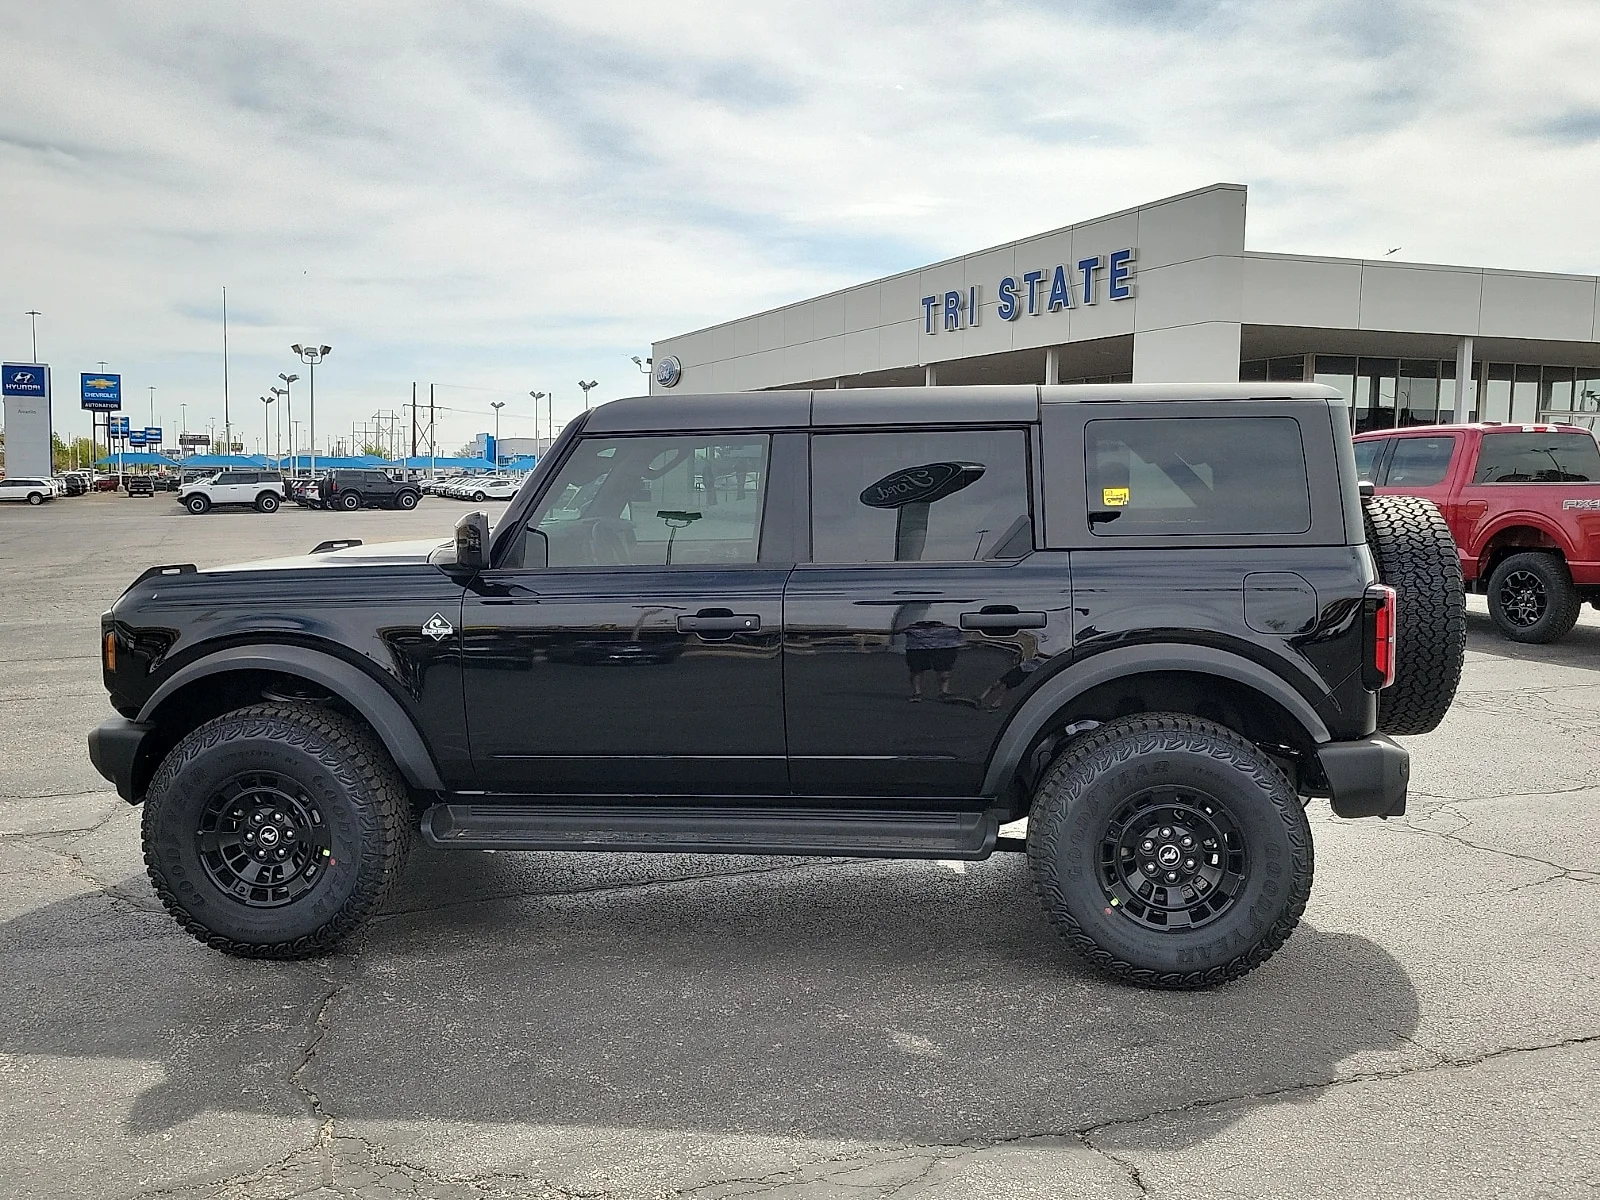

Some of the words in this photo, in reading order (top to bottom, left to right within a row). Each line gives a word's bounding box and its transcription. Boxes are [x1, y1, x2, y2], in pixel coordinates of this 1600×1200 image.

[921, 284, 981, 335] TRI
[997, 247, 1136, 321] STATE
[5, 383, 41, 391] HYUNDAI
[84, 391, 118, 399] CHEVROLET
